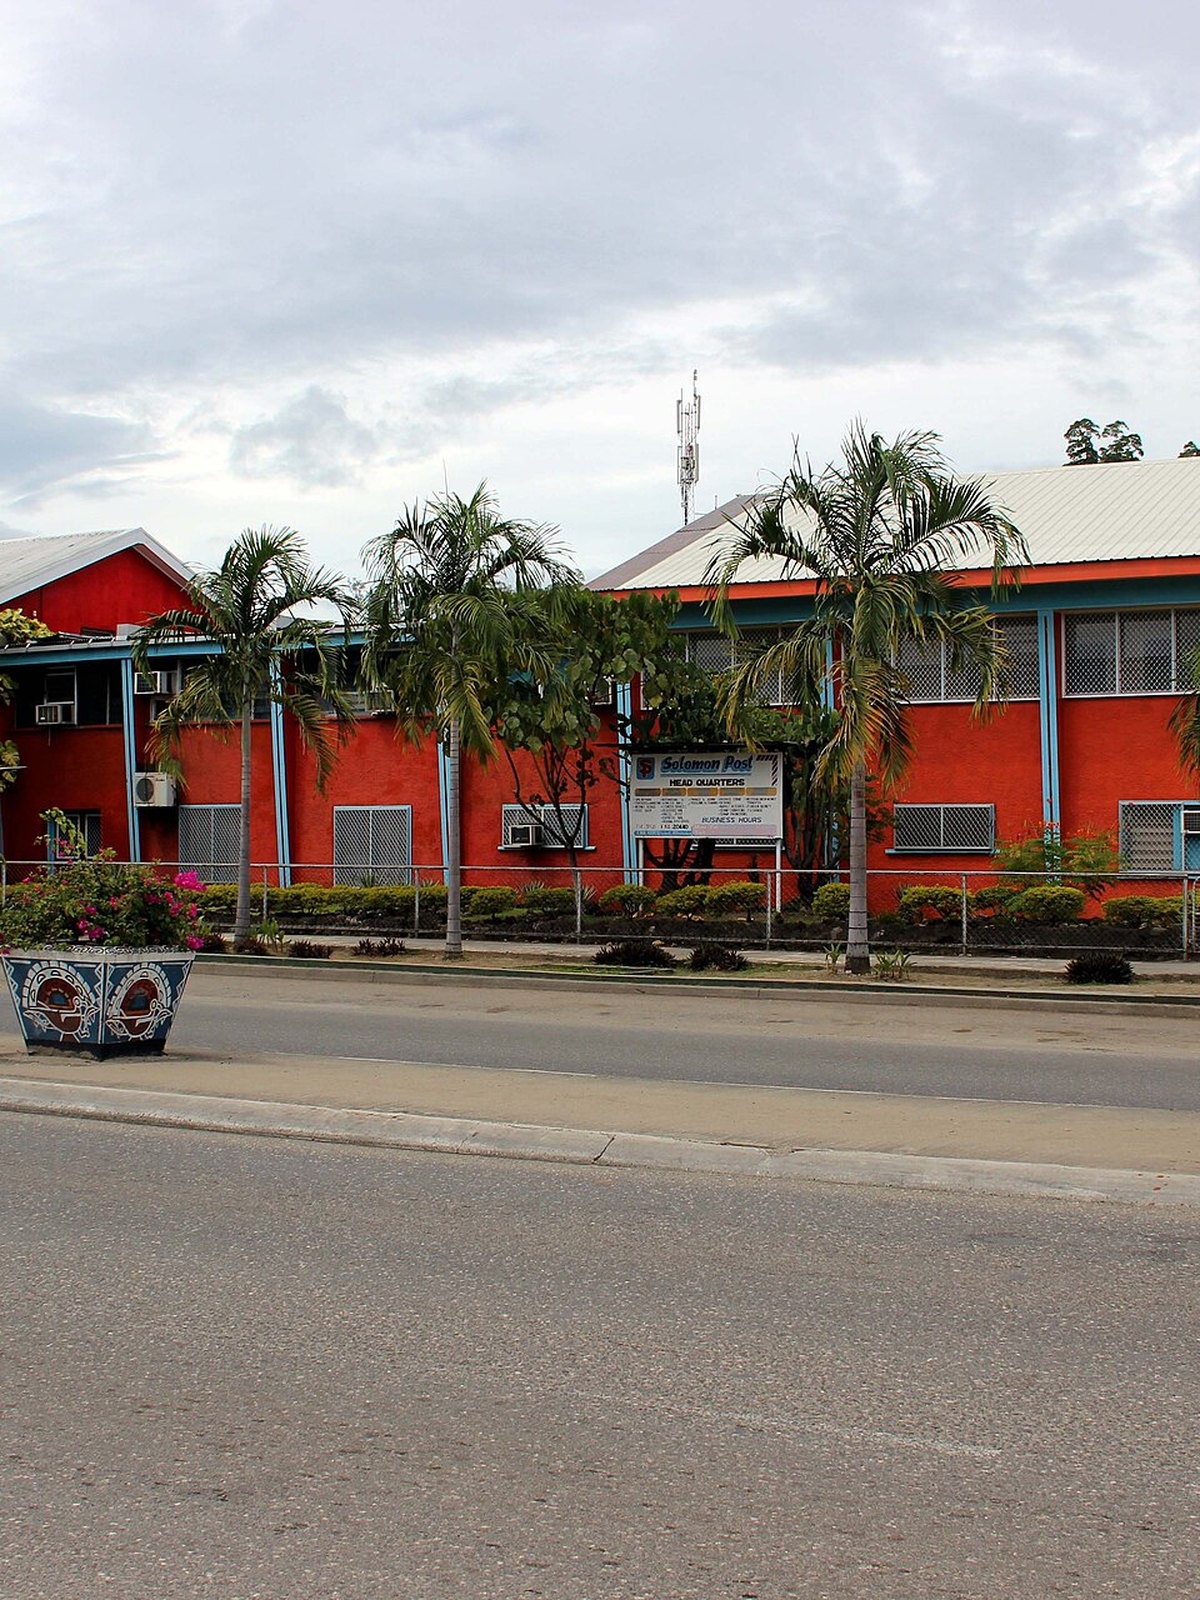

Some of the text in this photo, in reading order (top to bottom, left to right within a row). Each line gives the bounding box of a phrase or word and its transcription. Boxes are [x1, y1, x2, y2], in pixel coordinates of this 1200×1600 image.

[661, 755, 721, 772] Solomon
[722, 754, 754, 772] Post
[669, 778, 745, 787] HEAD QUARTERS
